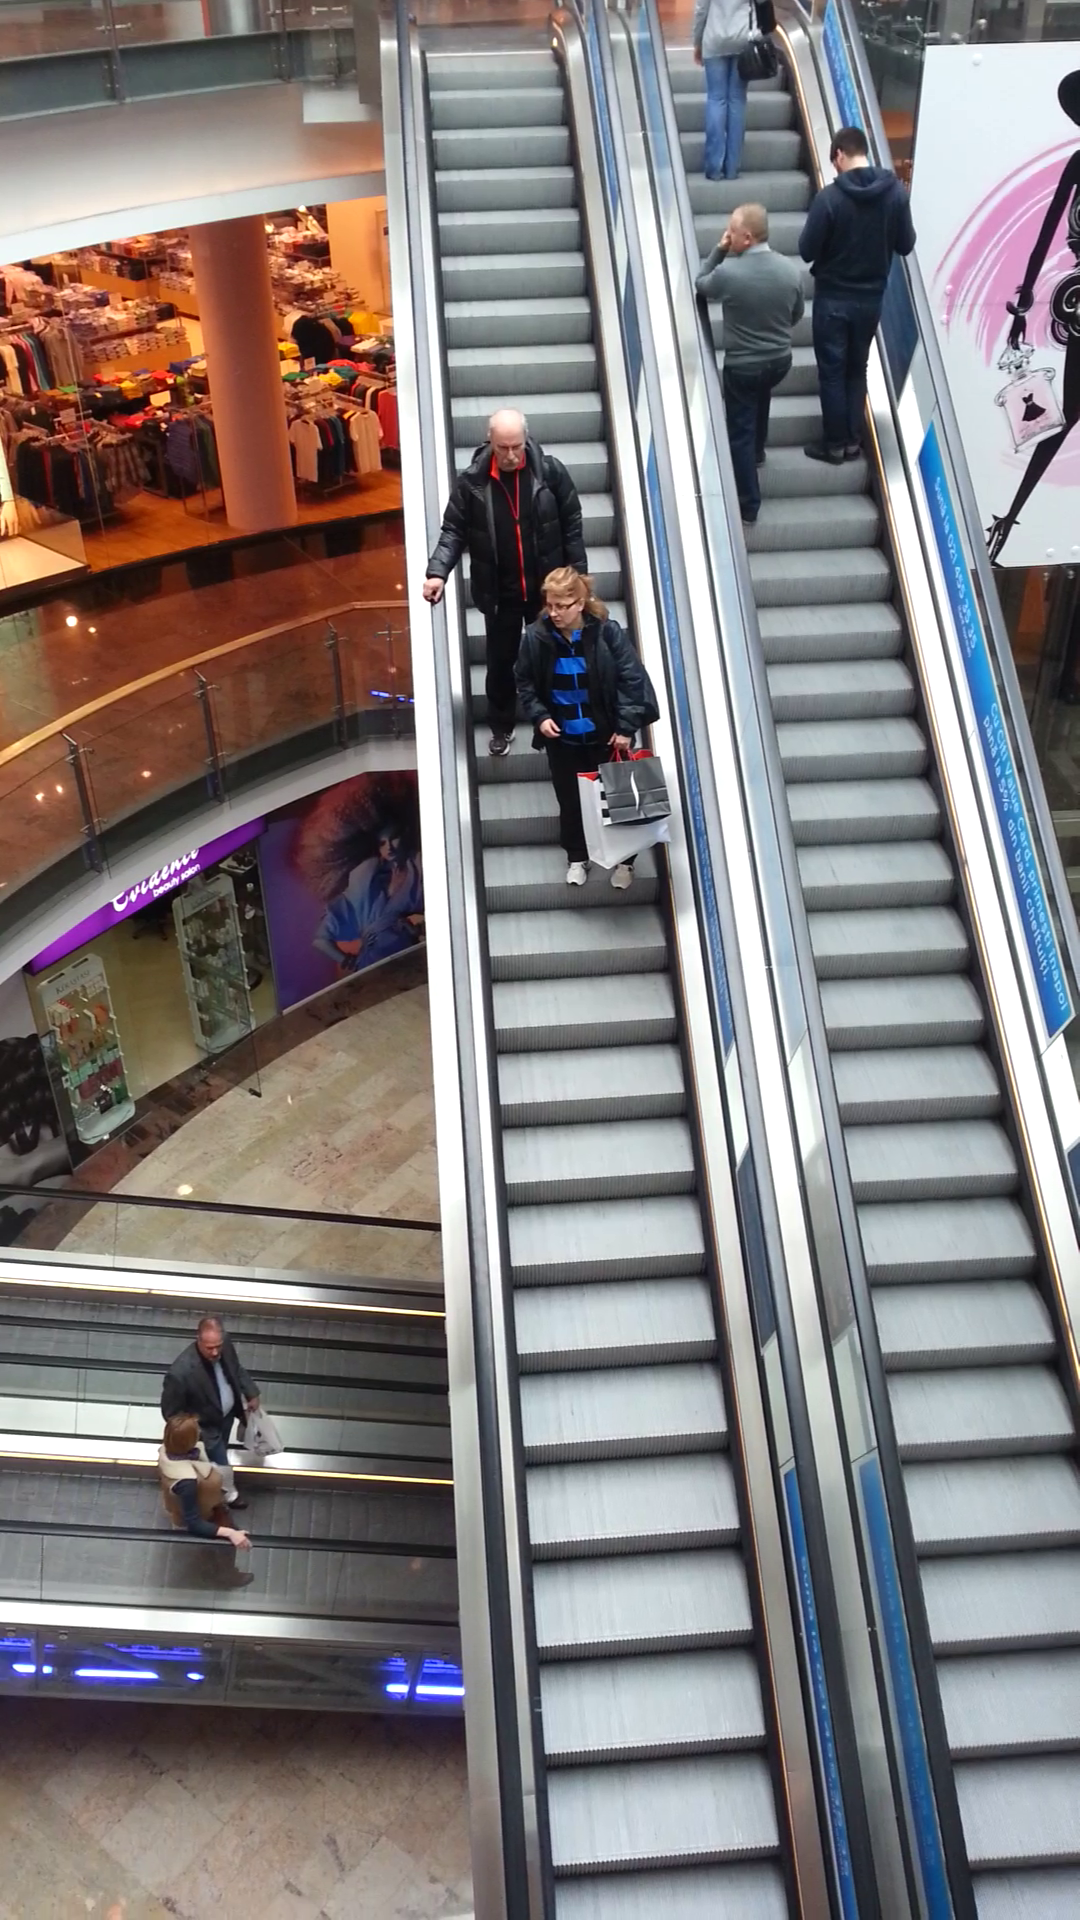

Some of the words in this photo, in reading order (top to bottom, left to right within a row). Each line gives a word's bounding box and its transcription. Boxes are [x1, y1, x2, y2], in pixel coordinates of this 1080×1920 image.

[948, 534, 958, 565] 021
[954, 566, 966, 599] 455
[962, 598, 971, 624] 35
[968, 622, 977, 649] 35
[991, 702, 1000, 728] Cu
[1005, 761, 1019, 813] Value
[152, 876, 180, 898] beauty
[180, 863, 200, 881] salon
[994, 758, 1001, 778] la
[1008, 819, 1017, 848] din
[1015, 848, 1031, 895] banii
